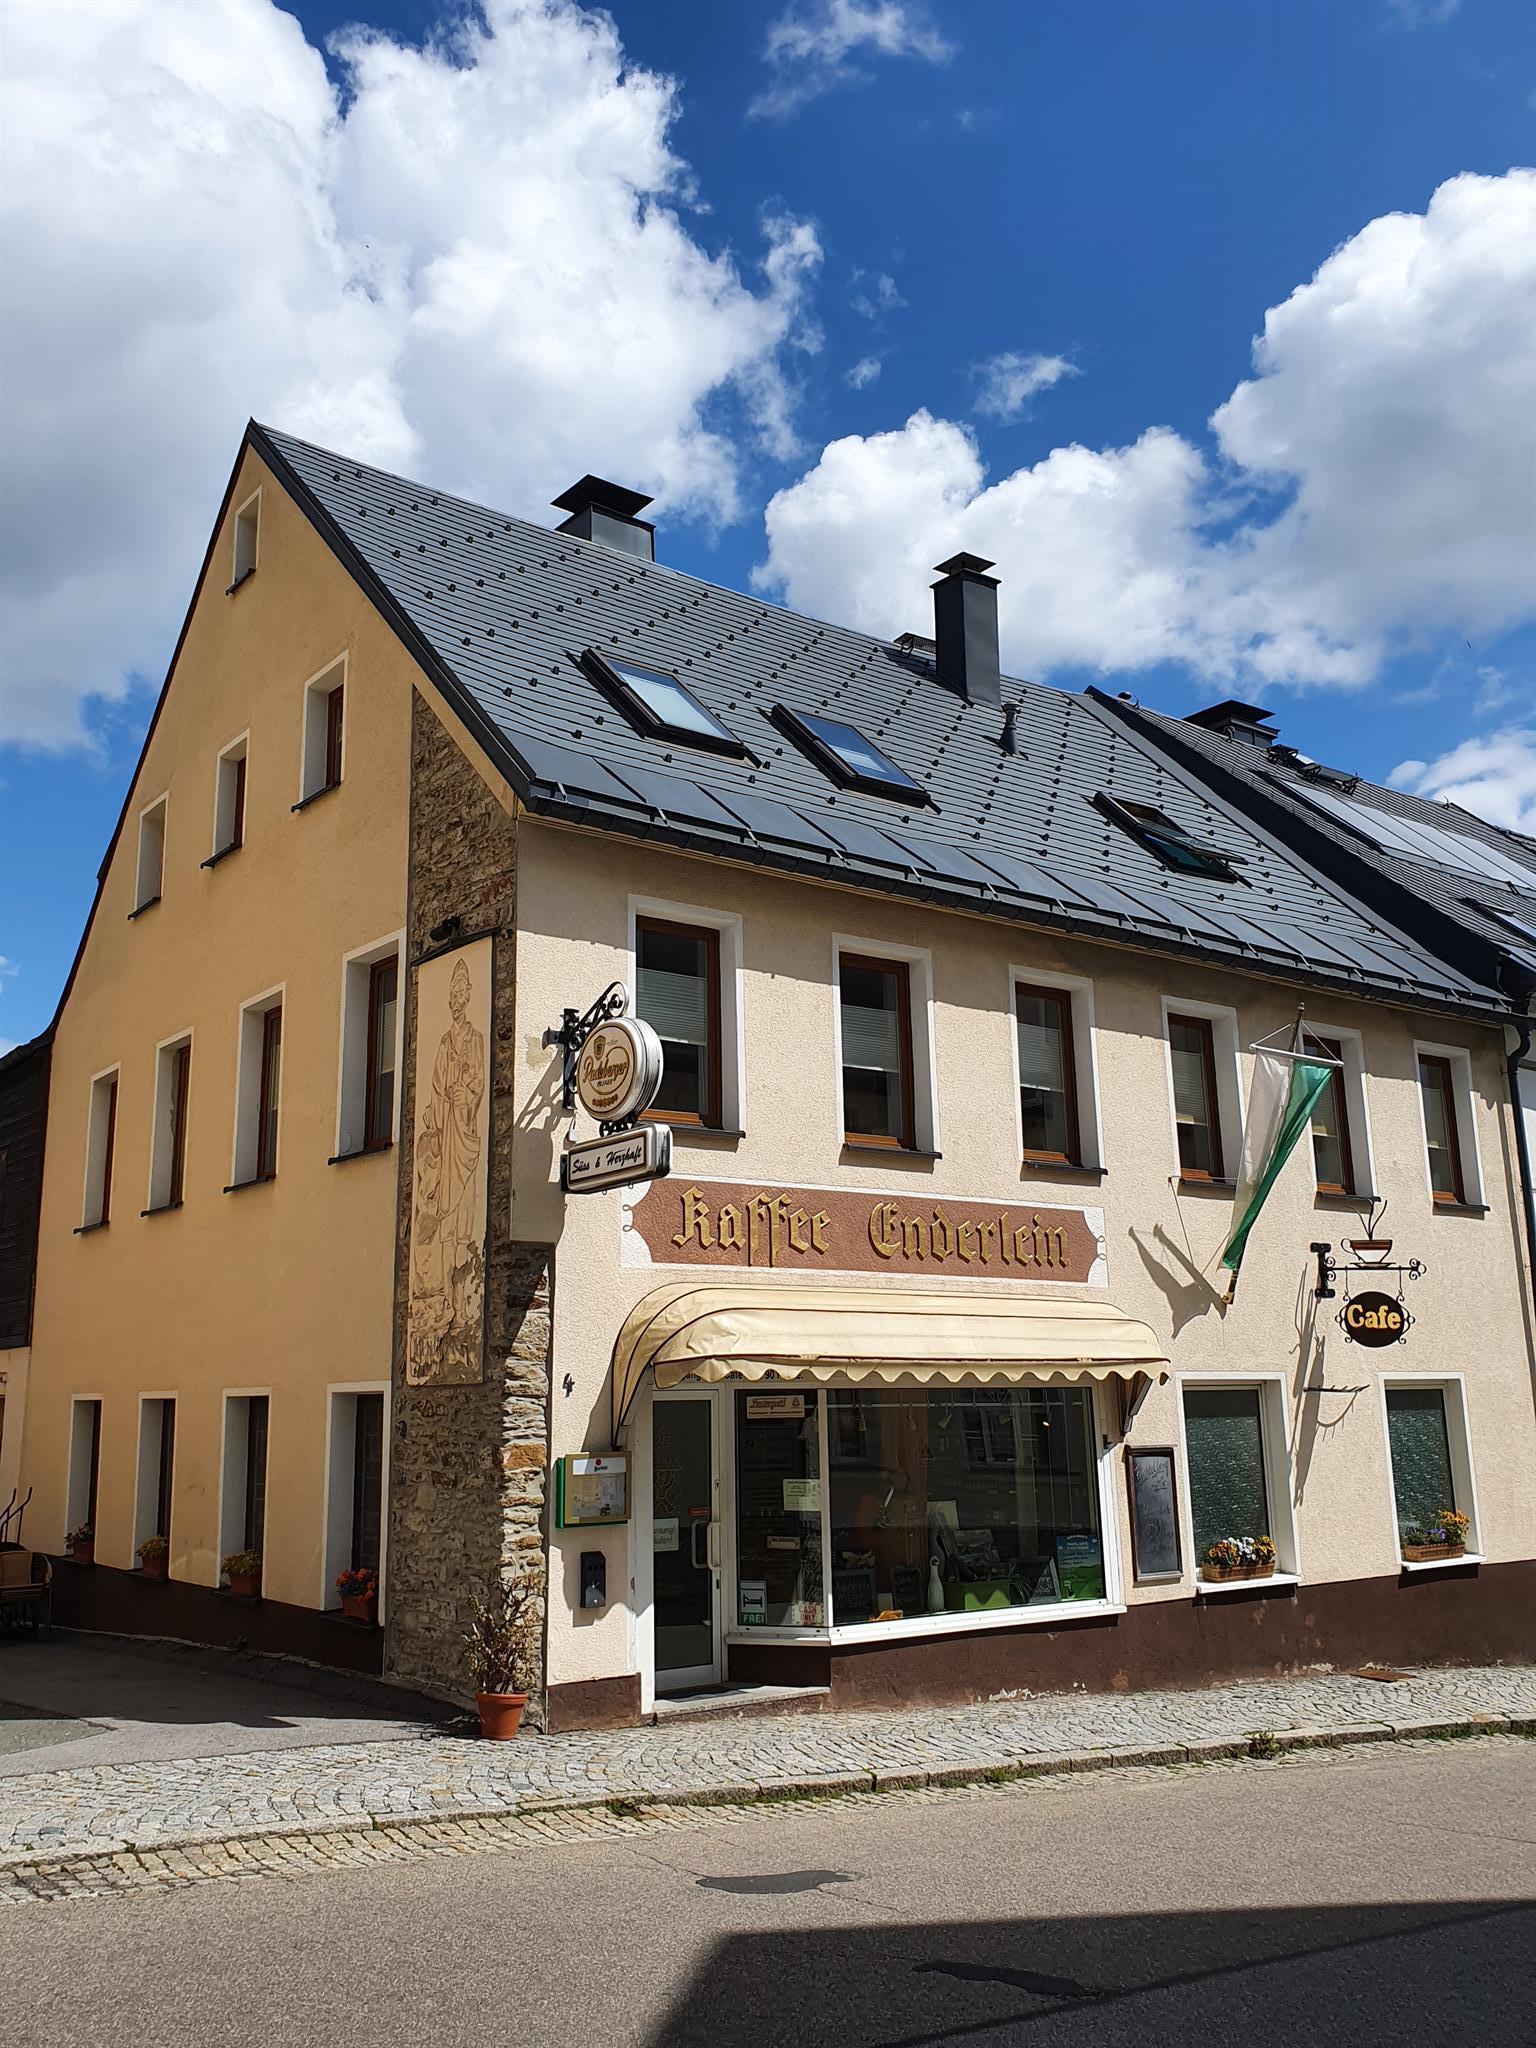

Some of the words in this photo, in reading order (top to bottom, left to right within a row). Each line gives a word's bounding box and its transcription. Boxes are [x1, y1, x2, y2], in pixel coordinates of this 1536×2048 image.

[583, 1056, 627, 1083] Radeberger
[572, 1158, 590, 1174] Süss
[606, 1146, 642, 1167] Herzhaft
[673, 1184, 832, 1267] Kaffee
[868, 1201, 1071, 1268] Enderlein
[1347, 1304, 1401, 1330] Cafe
[562, 1373, 575, 1398] 4
[743, 1614, 764, 1624] FREI
[799, 1605, 817, 1615] CASH
